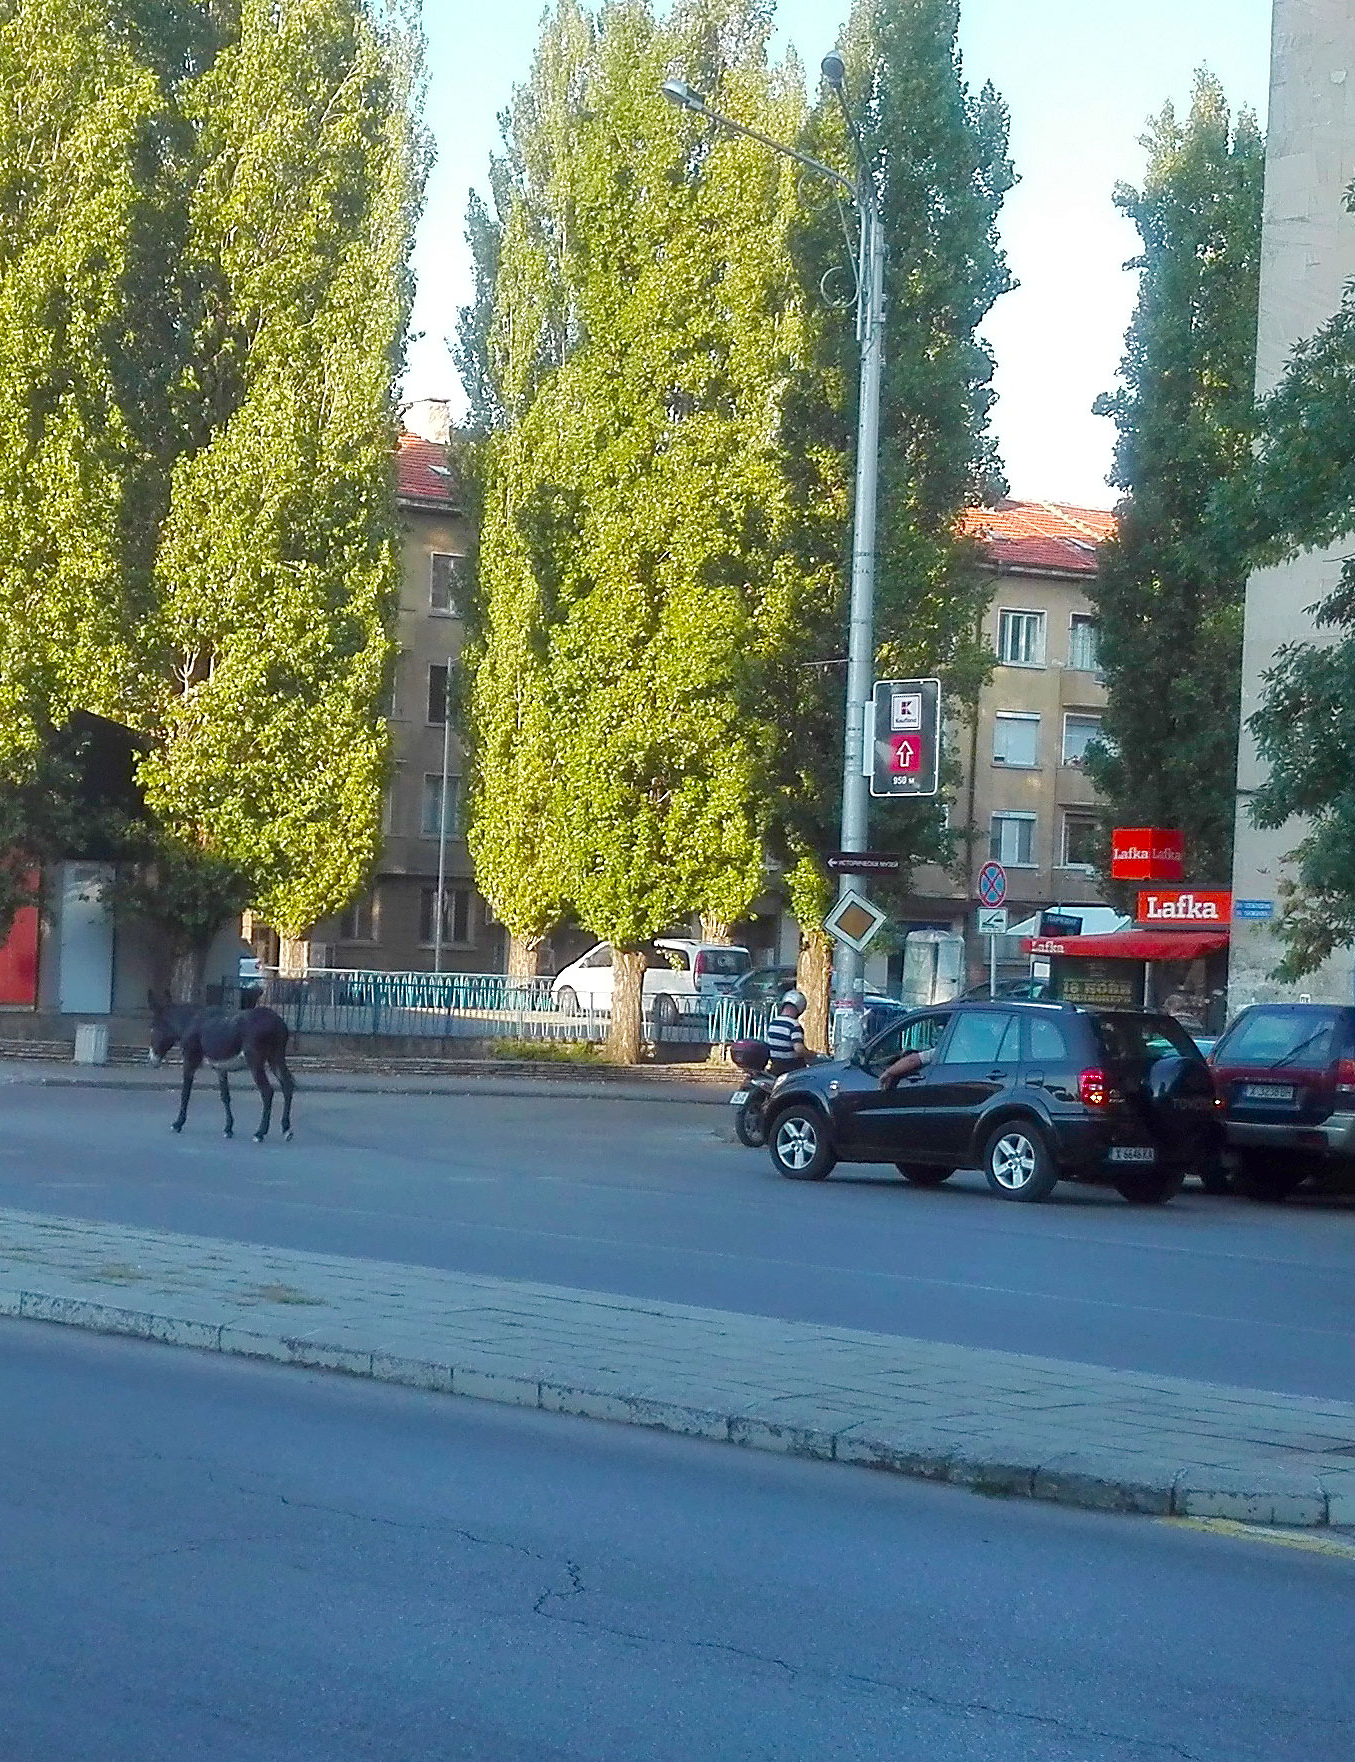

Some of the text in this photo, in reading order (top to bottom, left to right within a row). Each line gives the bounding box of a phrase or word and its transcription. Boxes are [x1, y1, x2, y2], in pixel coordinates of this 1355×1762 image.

[1113, 847, 1149, 860] Lafka
[1152, 848, 1182, 860] Lafka
[1146, 894, 1219, 920] Lafka
[1030, 940, 1065, 954] Lafka
